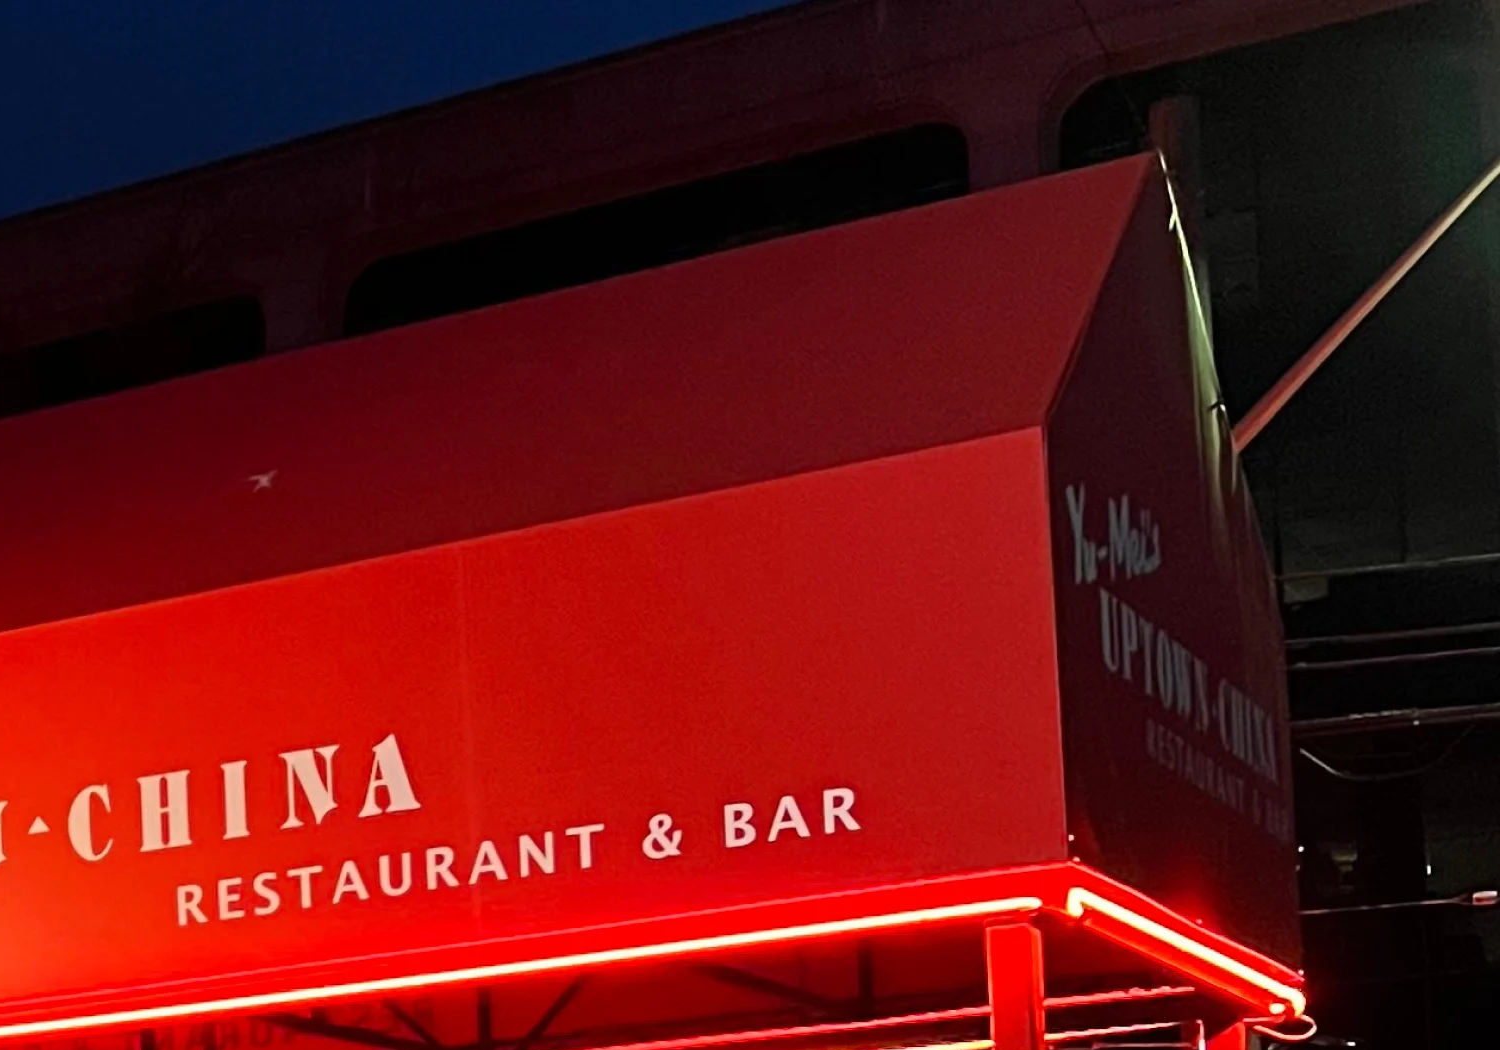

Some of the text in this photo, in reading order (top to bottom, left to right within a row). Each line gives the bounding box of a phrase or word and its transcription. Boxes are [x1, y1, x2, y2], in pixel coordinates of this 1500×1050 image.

[1066, 482, 1162, 584] Yu-Mei's
[1099, 587, 1278, 785] UPTOWN CHINA
[68, 734, 422, 861] CHINA
[177, 788, 861, 926] RESTAURANT & BAR
